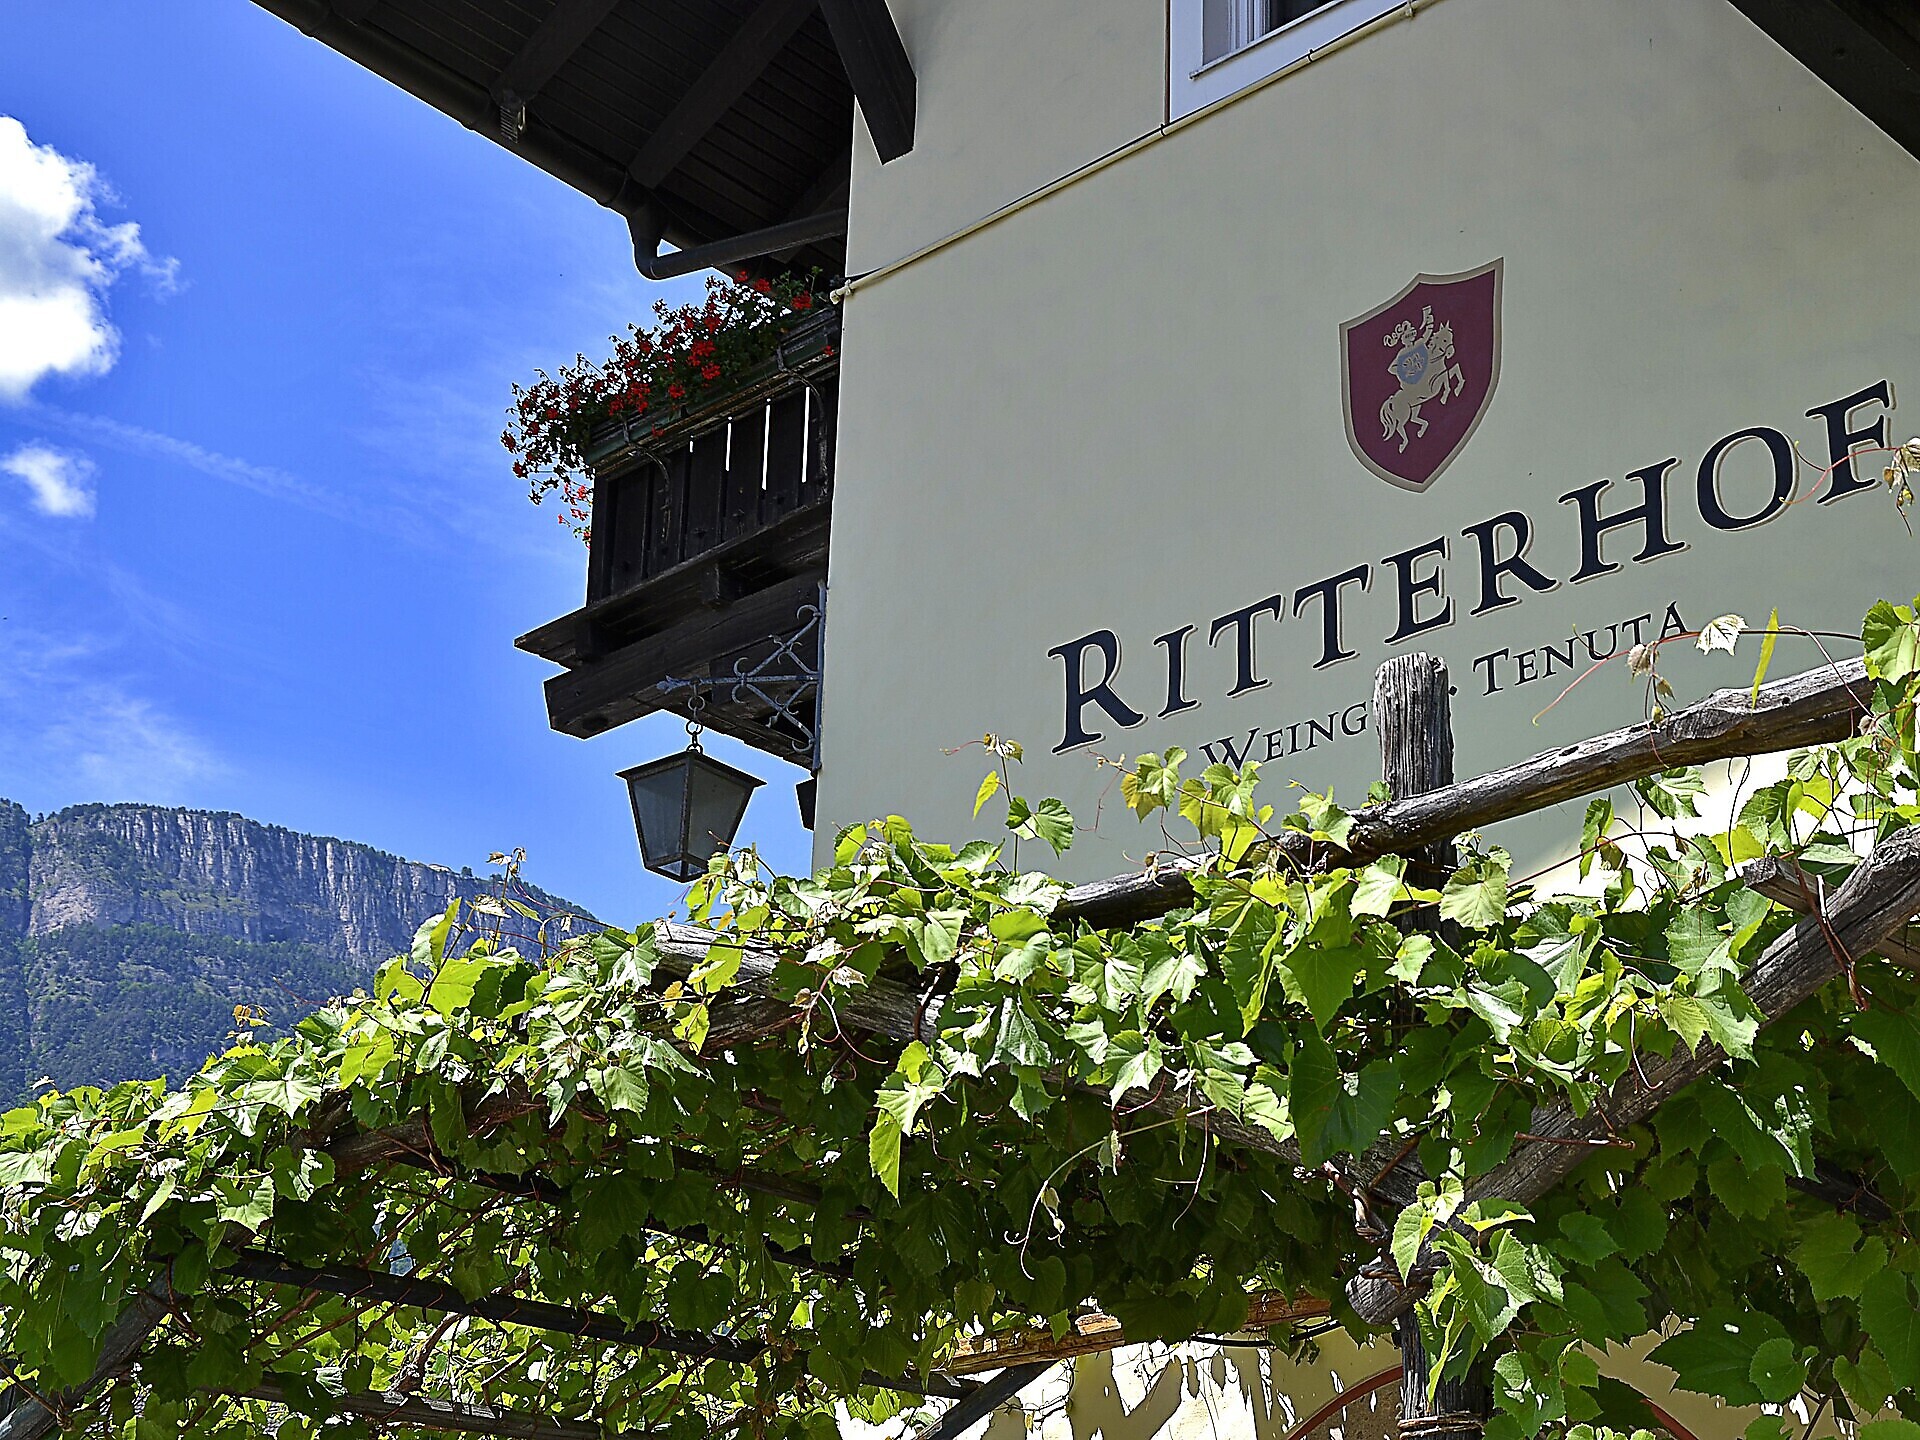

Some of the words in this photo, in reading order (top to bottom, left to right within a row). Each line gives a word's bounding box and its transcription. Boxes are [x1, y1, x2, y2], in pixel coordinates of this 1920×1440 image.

[1047, 379, 1894, 755] RITTERHOF
[1199, 699, 1374, 772] WEING
[1472, 600, 1689, 697] TENUTA
